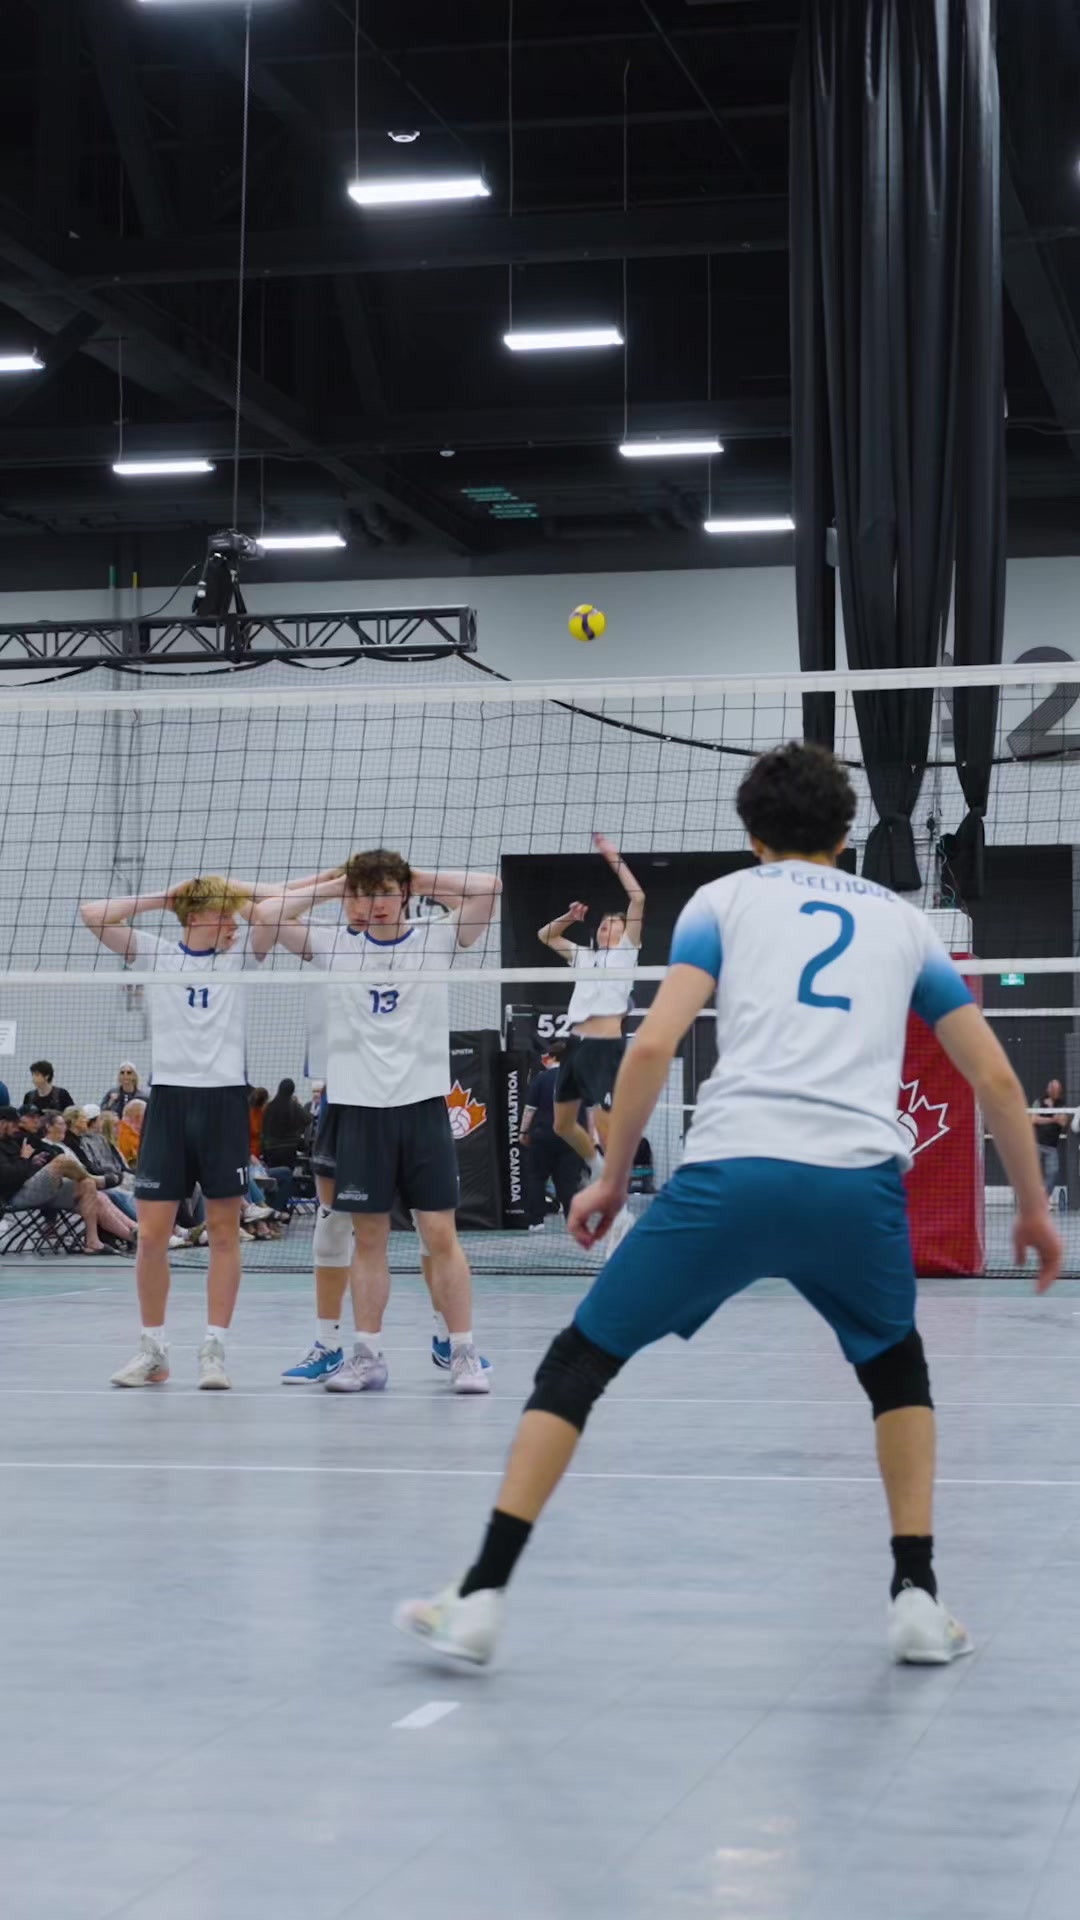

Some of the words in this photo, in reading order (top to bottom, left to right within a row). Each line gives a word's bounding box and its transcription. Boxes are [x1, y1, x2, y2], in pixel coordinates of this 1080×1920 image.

[797, 900, 856, 1013] 2
[186, 987, 209, 1008] 11
[369, 989, 399, 1013] 13
[537, 1014, 571, 1038] 52
[507, 1070, 519, 1145] VOLLEYBALL
[509, 1147, 522, 1203] CANADA
